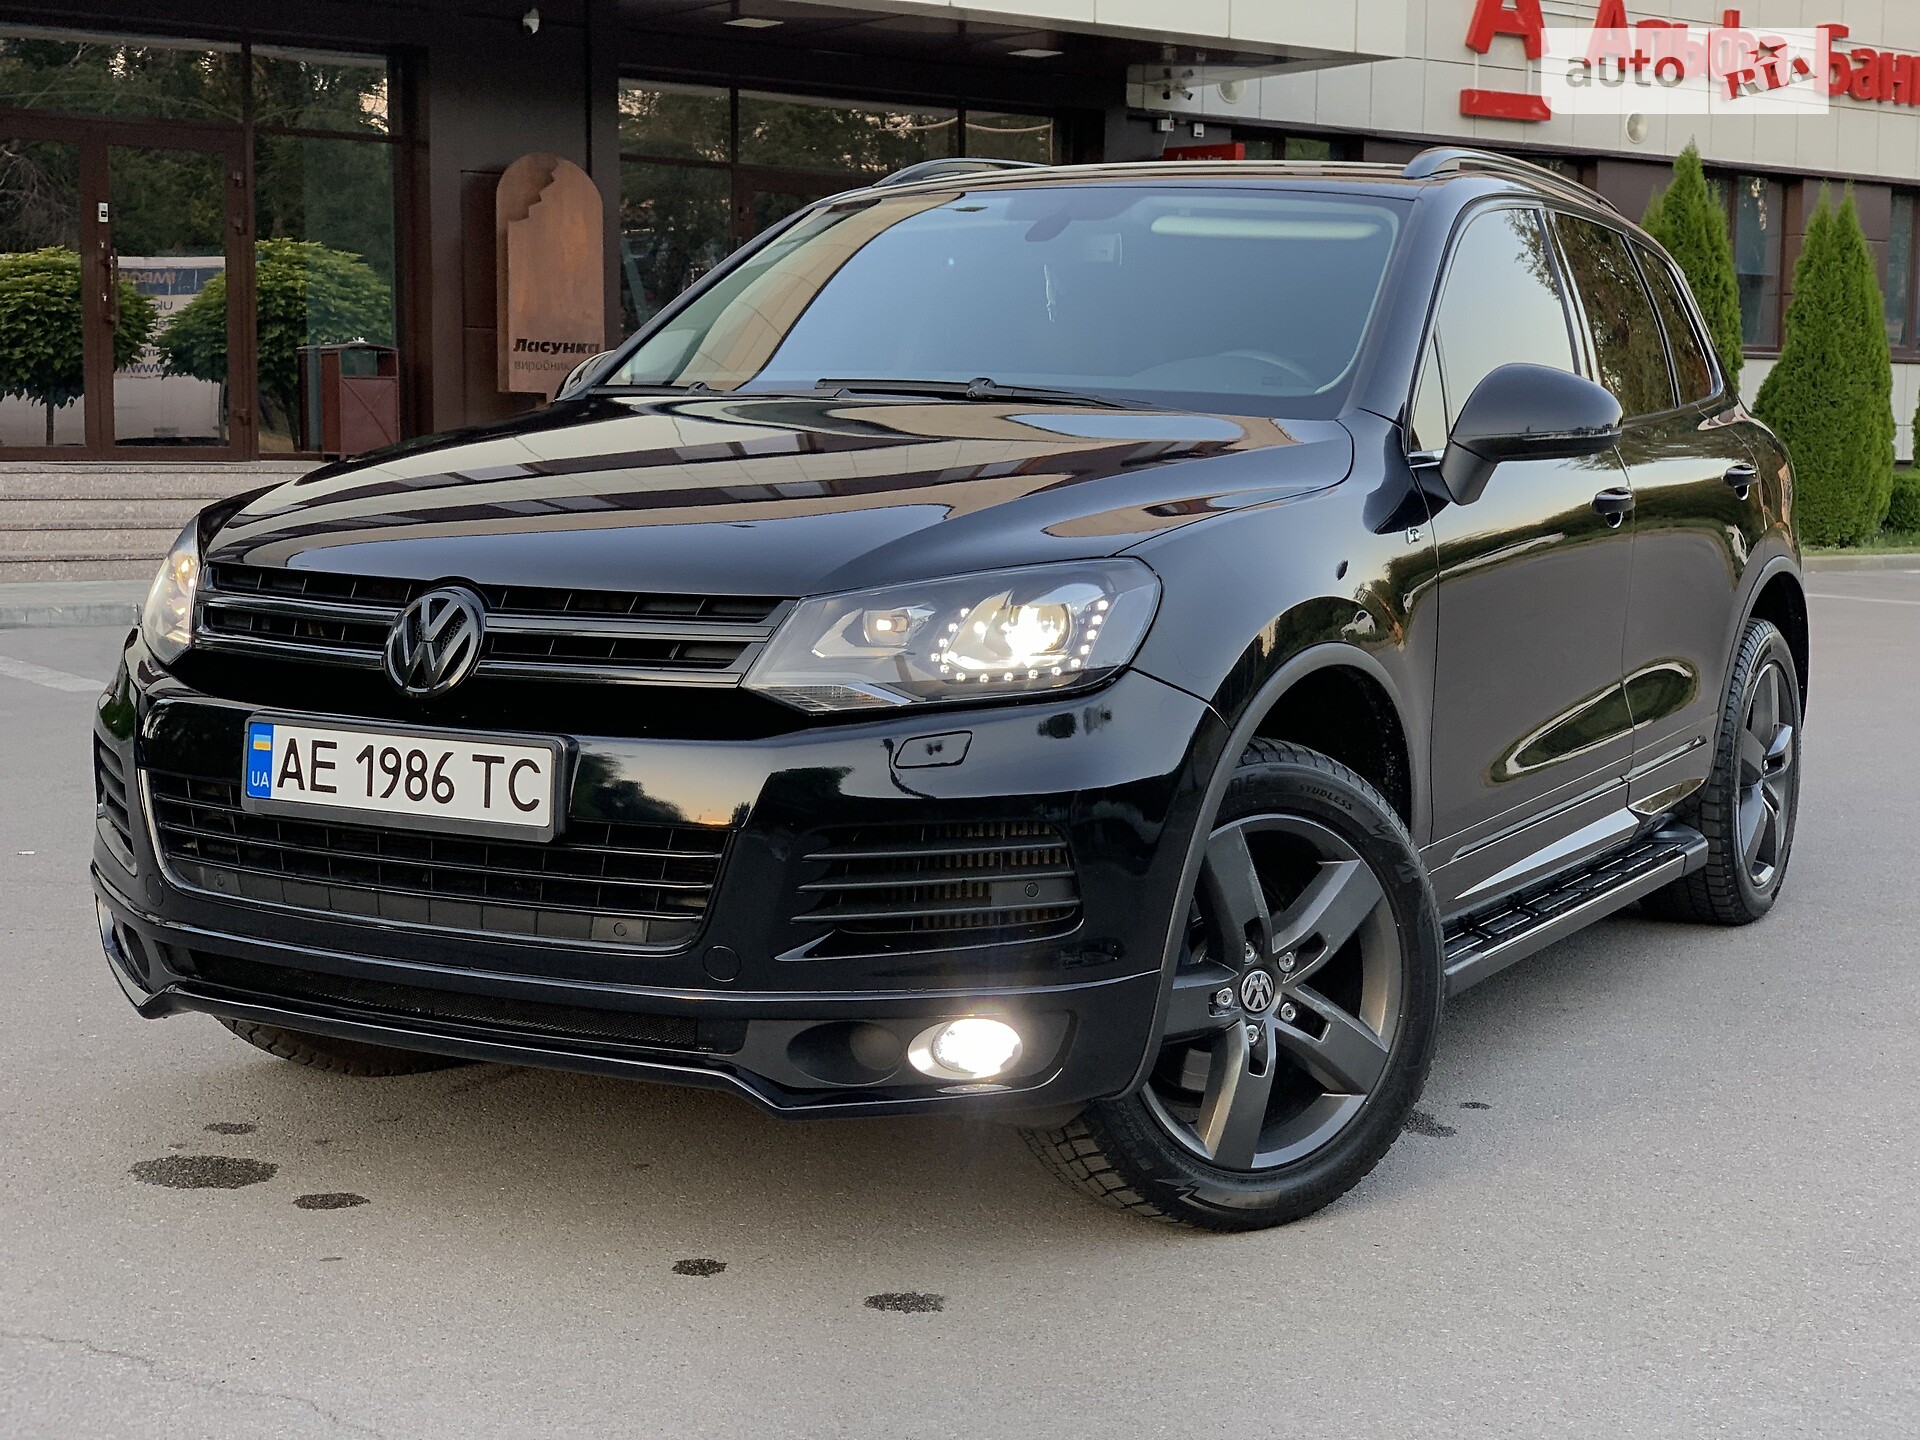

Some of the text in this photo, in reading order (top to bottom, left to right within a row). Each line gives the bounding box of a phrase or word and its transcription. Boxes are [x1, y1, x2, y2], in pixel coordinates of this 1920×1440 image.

[513, 338, 600, 355] Ласунка
[251, 771, 270, 788] UA
[276, 737, 541, 812] AE 1986 TC
[1298, 783, 1354, 811] STUDLESS
